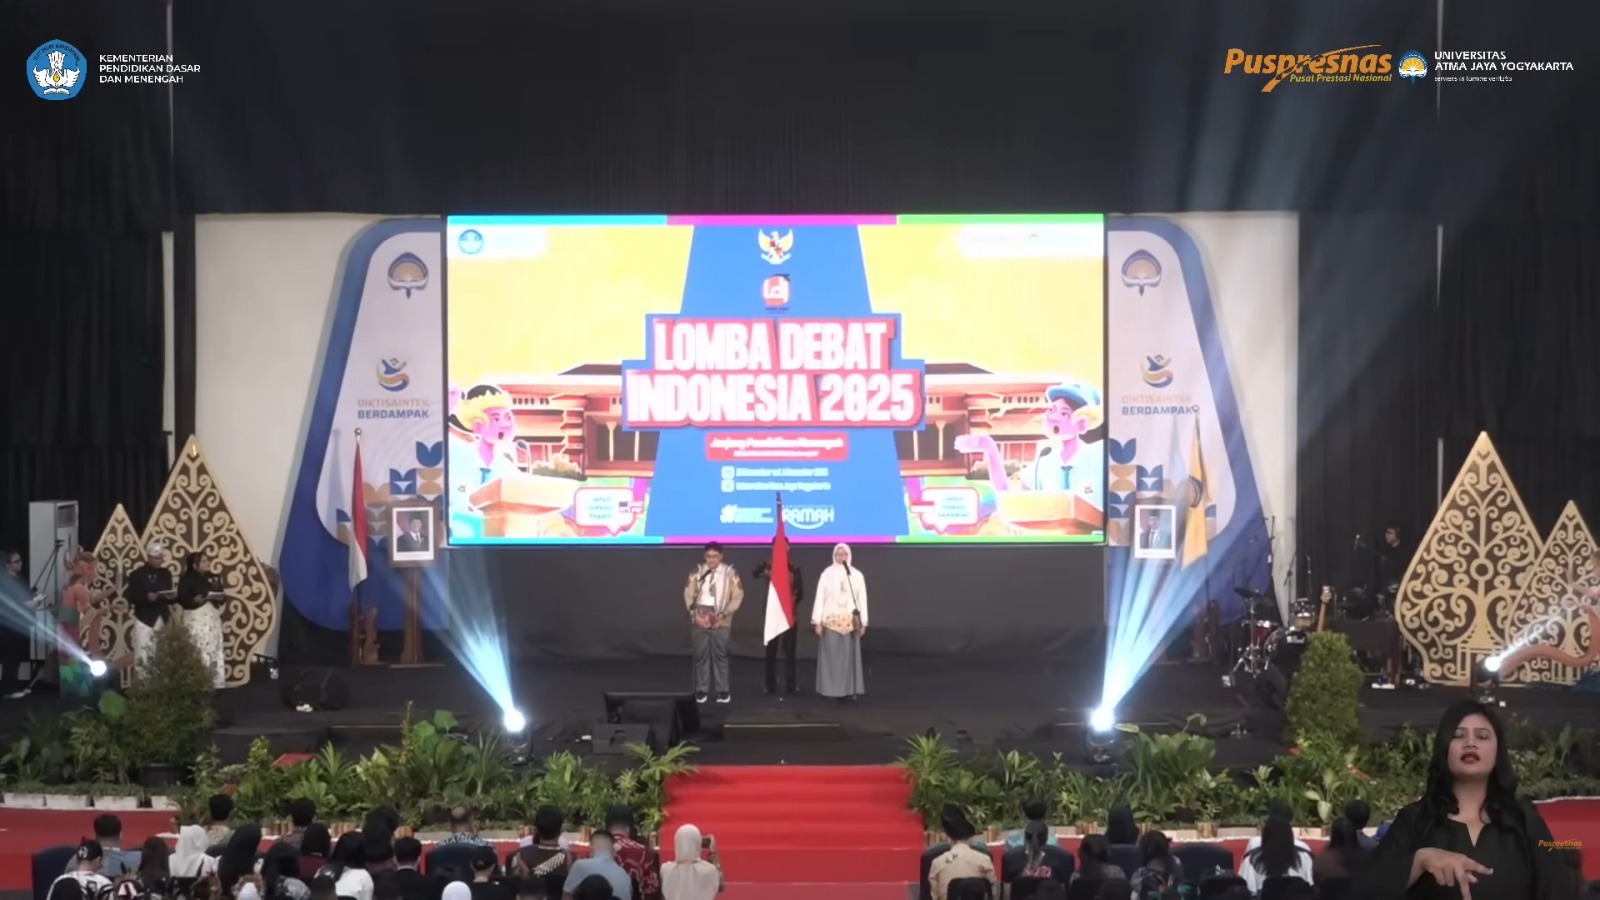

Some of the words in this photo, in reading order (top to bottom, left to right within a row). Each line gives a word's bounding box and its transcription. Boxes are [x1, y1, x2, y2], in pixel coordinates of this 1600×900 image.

[653, 321, 773, 371] LOMBA
[779, 321, 887, 371] DEBAT
[626, 373, 812, 422] INDONESIA
[357, 409, 430, 419] BERDAMPAK
[1121, 405, 1192, 416] BERDAMPAK
[782, 507, 835, 523] RAMAH
